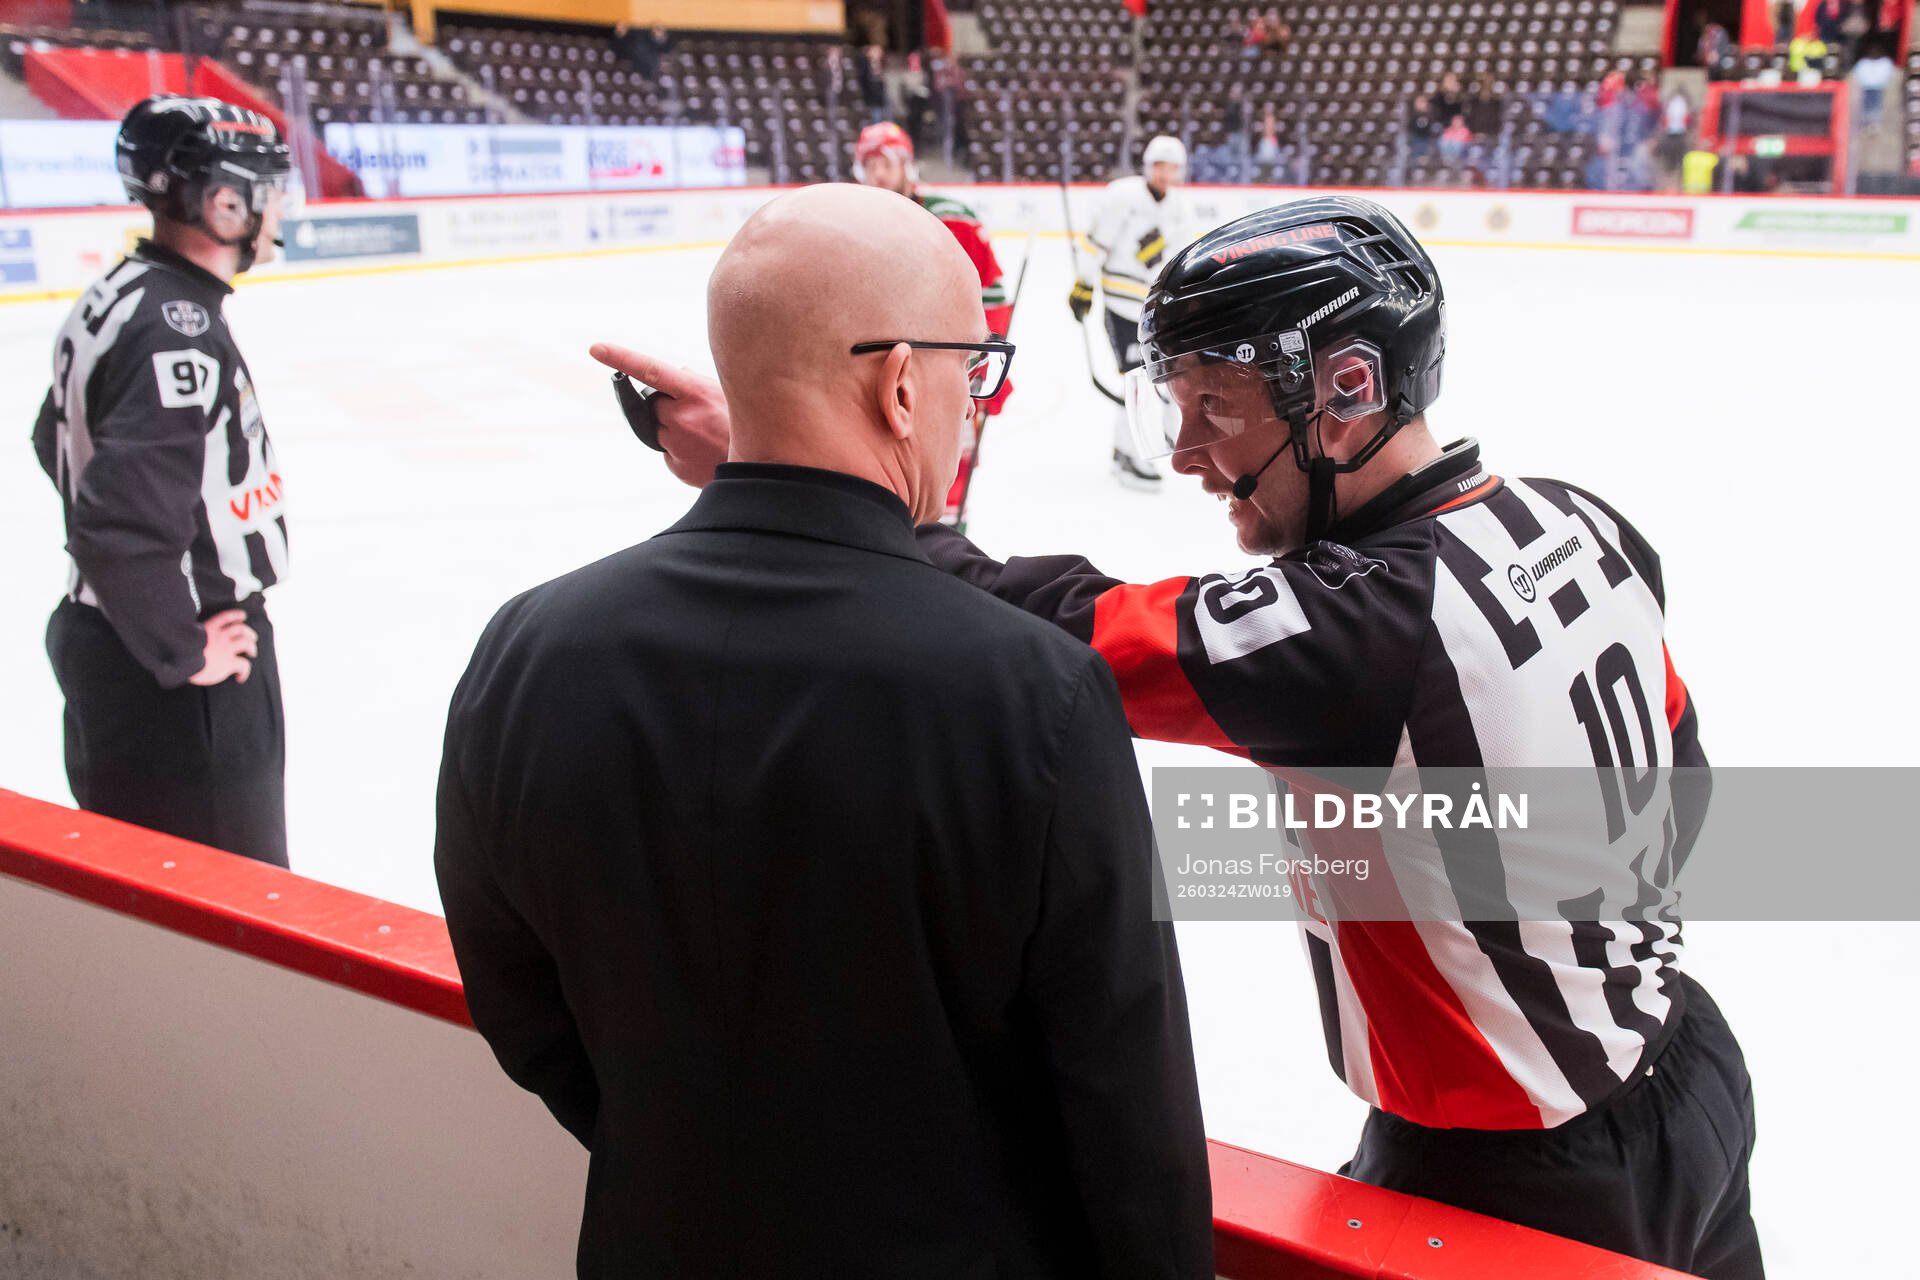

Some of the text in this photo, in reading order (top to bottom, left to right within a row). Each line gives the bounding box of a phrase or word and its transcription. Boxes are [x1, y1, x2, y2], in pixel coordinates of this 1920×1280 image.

[1212, 224, 1336, 265] VIKING LINE
[1296, 286, 1360, 329] WARRIOR
[1531, 536, 1582, 581] WARRIOR
[1569, 642, 1658, 845] 10
